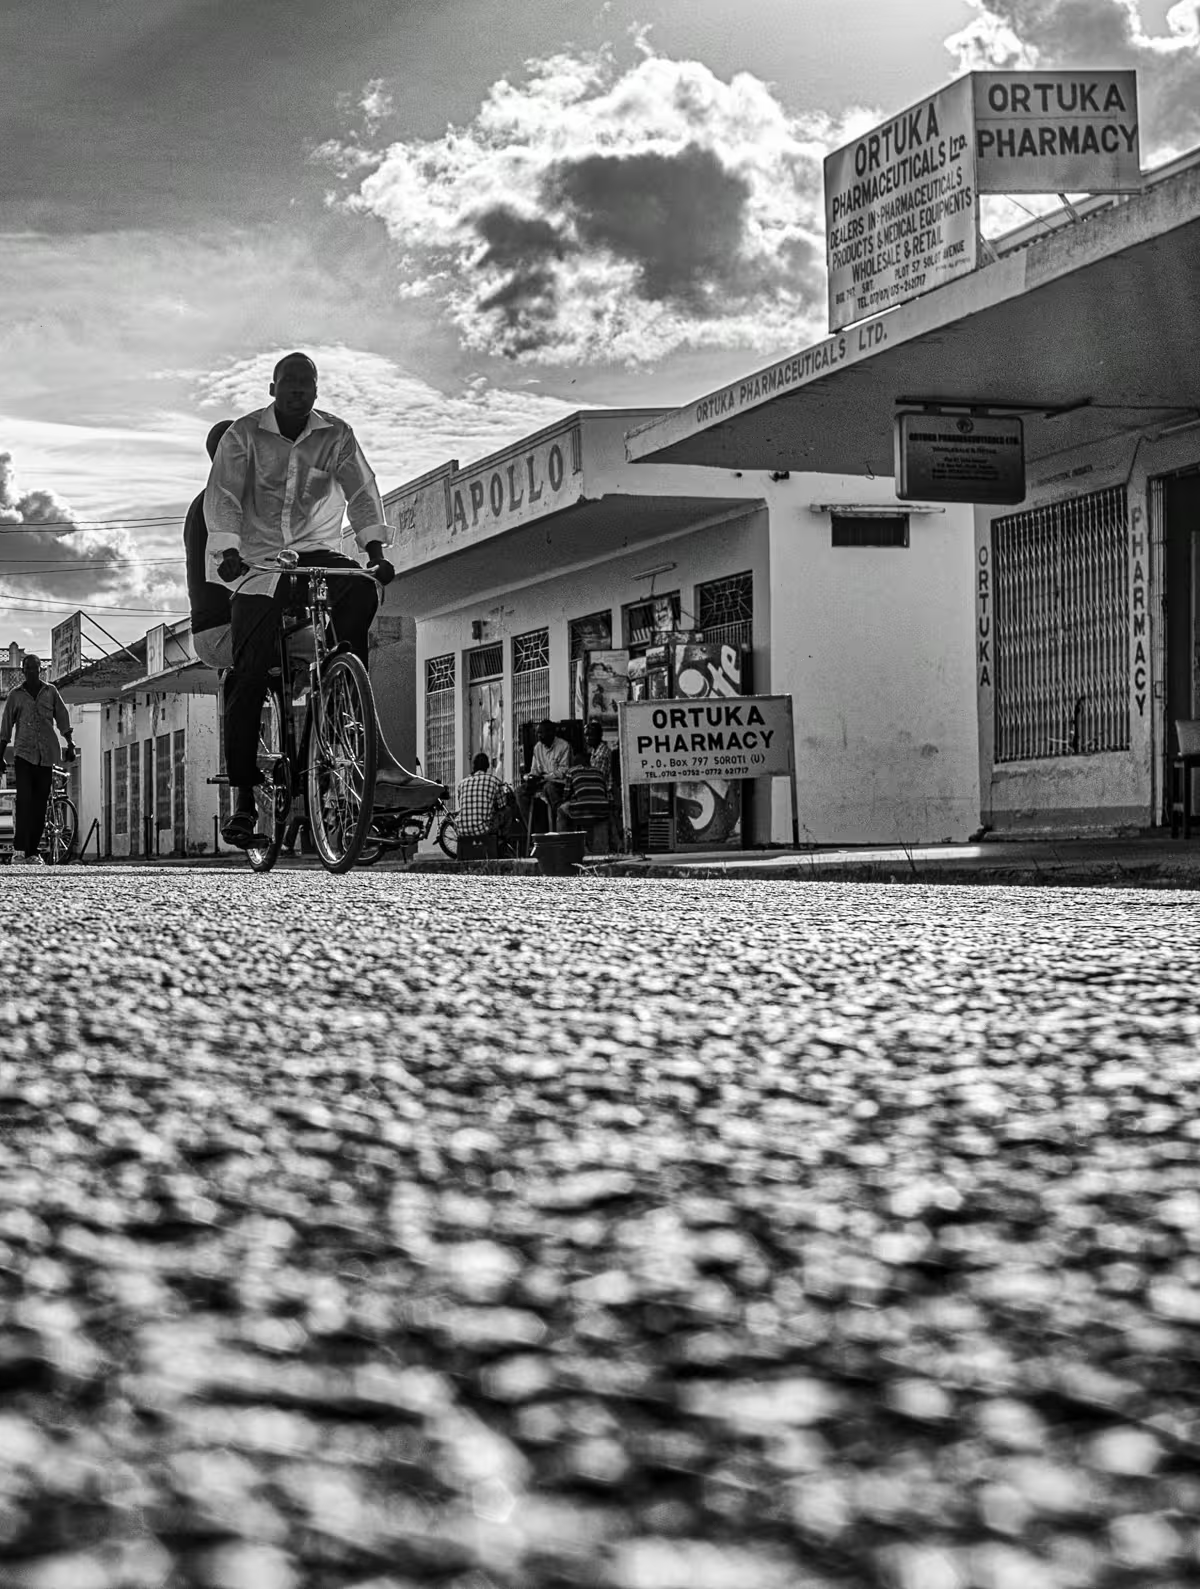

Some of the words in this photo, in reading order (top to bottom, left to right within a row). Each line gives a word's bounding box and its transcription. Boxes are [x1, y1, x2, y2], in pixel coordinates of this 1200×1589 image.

[988, 83, 1126, 112] ORTUKA
[855, 102, 939, 177] ORTUKA
[977, 124, 1138, 158] PHARMACY
[830, 216, 864, 250] DEALERS
[880, 166, 962, 224] PHARMACEUTICALS
[832, 141, 946, 222] PHARMACEUTICALS
[832, 233, 873, 271] PRODUCTS
[877, 231, 883, 250] &
[883, 213, 917, 248] MEDICAL
[919, 186, 972, 229] EQUIPMENTS
[852, 245, 901, 283] WHOLESALE
[904, 241, 911, 259] &
[912, 226, 944, 256] RETAIL
[895, 262, 909, 280] PLOT
[943, 240, 965, 259] AVENUE
[696, 391, 735, 423] ORTUKA
[739, 338, 846, 405] PHARMACEUTICALS
[858, 322, 887, 352] LTD.
[451, 444, 563, 536] APOLLO
[977, 547, 991, 688] ORTUKA
[1130, 506, 1146, 717] PHARMACY
[637, 730, 774, 754] PHARMACY
[652, 705, 766, 729] ORTUKA
[692, 757, 709, 767] 797
[714, 755, 746, 765] SOROTI
[750, 754, 765, 765] (U)
[725, 767, 749, 775] 621717
